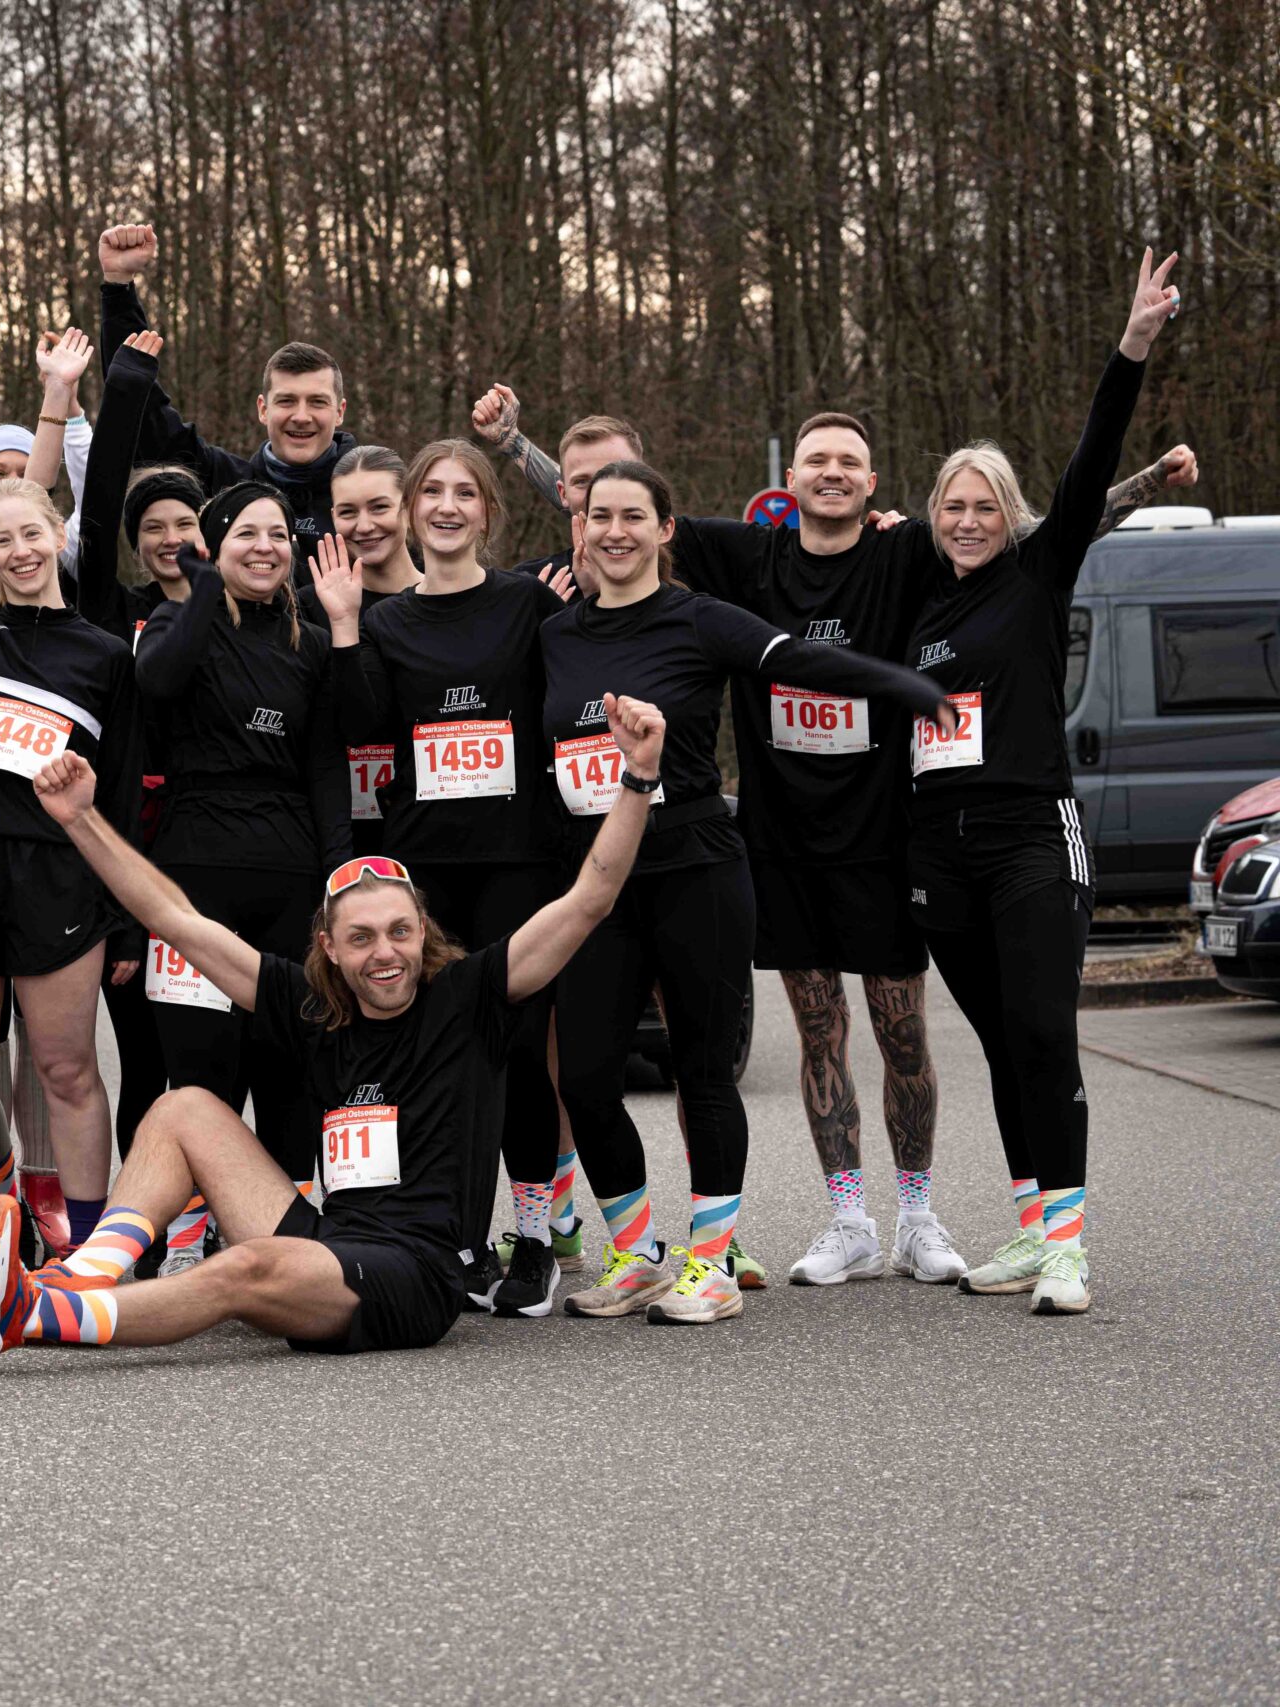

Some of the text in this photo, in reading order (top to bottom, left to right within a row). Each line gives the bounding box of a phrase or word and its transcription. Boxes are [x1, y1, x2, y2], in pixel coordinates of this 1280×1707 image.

[805, 619, 844, 640] HL
[920, 640, 950, 664] HL
[916, 652, 956, 672] TRAINING CLUB
[444, 686, 480, 707] HL
[946, 695, 977, 704] tseelauf
[438, 702, 486, 714] TRAINING CLUB
[780, 700, 854, 730] 1061
[26, 706, 68, 728] Ostseelauf
[252, 708, 284, 729] HL
[575, 716, 606, 727] TRAINING
[246, 723, 274, 734] TRAINING
[419, 722, 506, 734] Sparkassen Ostseelauf
[805, 731, 833, 739] Hannes
[350, 748, 394, 756] Sparkassen
[560, 739, 599, 752] Sparkassen
[936, 744, 954, 752] Alina
[424, 738, 504, 772] 1459
[355, 764, 392, 792] 14
[438, 772, 488, 782] Emily Sophie
[566, 752, 622, 790] 147
[593, 788, 620, 797] Malwin
[155, 943, 200, 978] 19
[168, 978, 200, 988] Caroline
[346, 1083, 384, 1105] HL
[348, 1107, 390, 1118] Ostseelauf
[328, 1126, 370, 1163] 911
